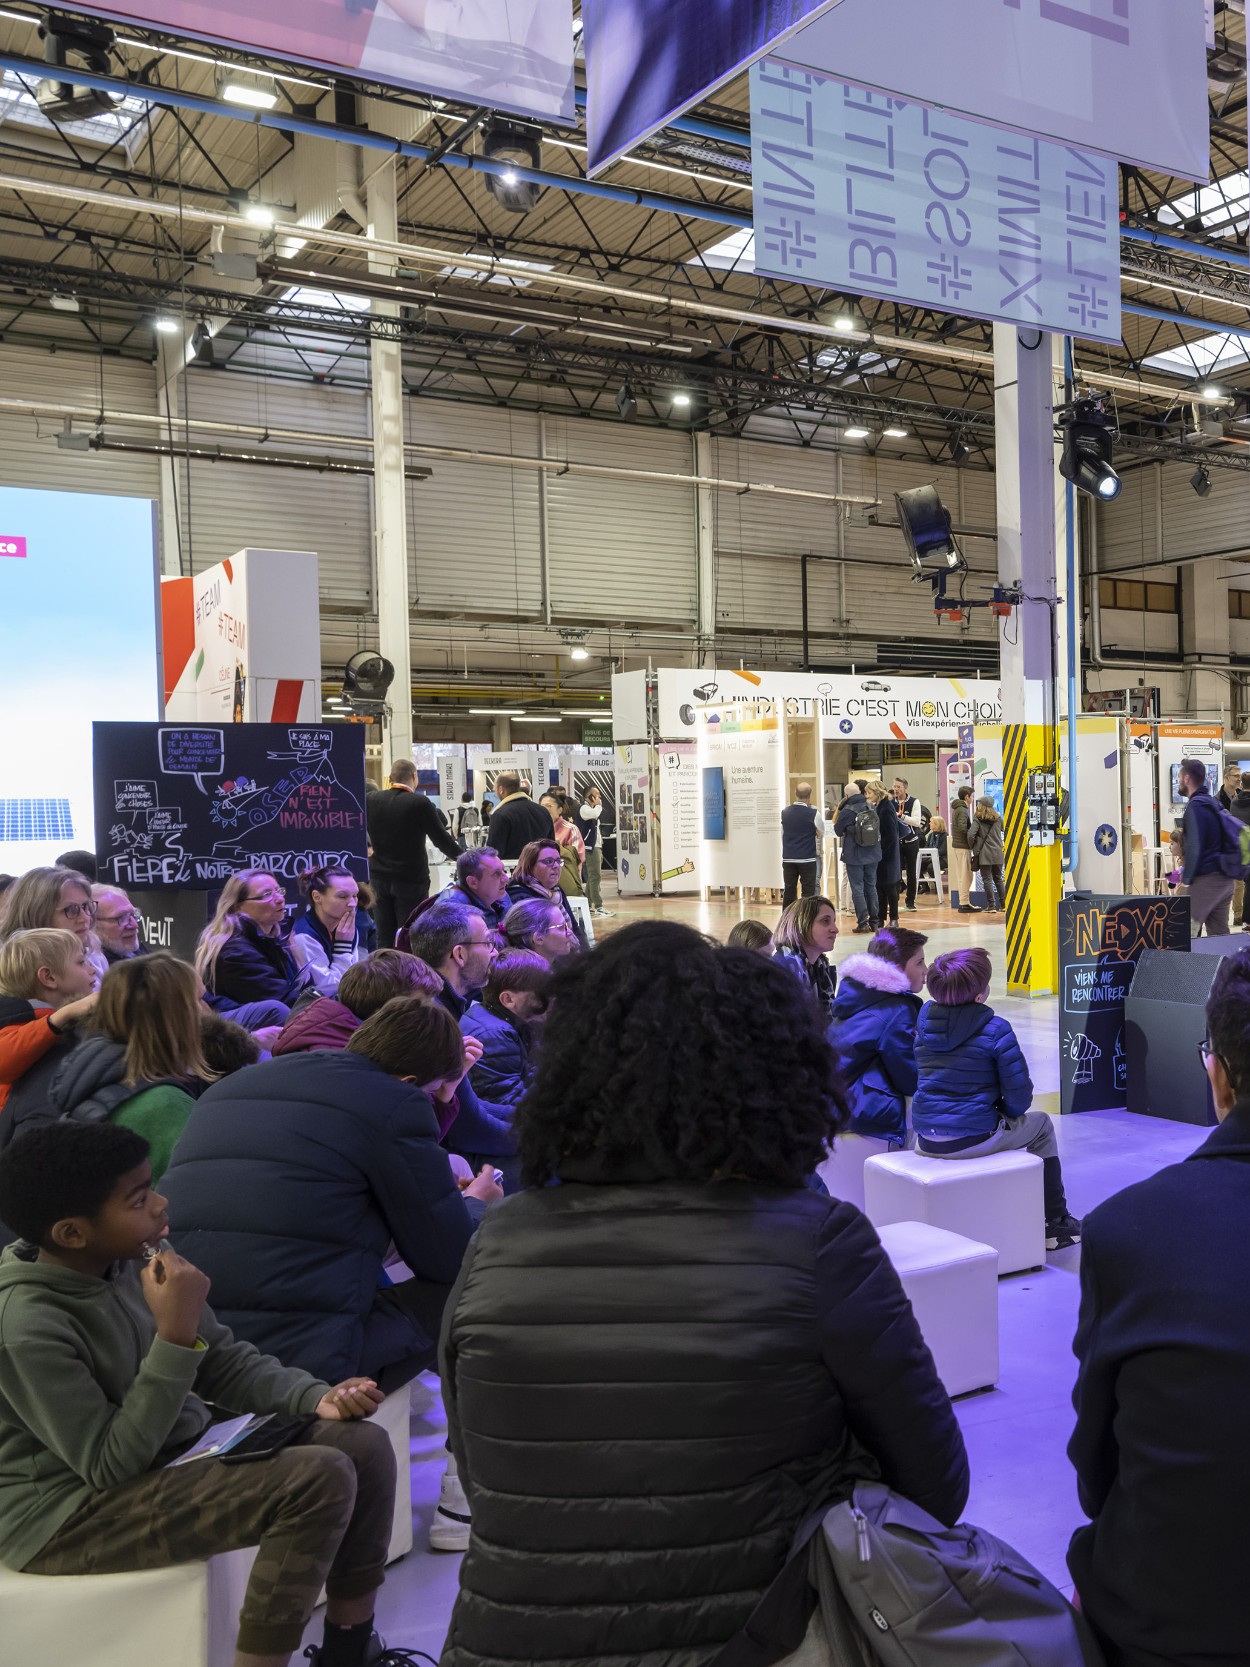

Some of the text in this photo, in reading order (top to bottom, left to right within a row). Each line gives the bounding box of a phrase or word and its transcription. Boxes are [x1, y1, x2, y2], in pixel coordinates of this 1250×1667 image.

[846, 698, 900, 717] C'EST
[907, 719, 920, 728] Vis
[731, 766, 741, 775] Une
[1072, 985, 1126, 1004] RENCONTRER
